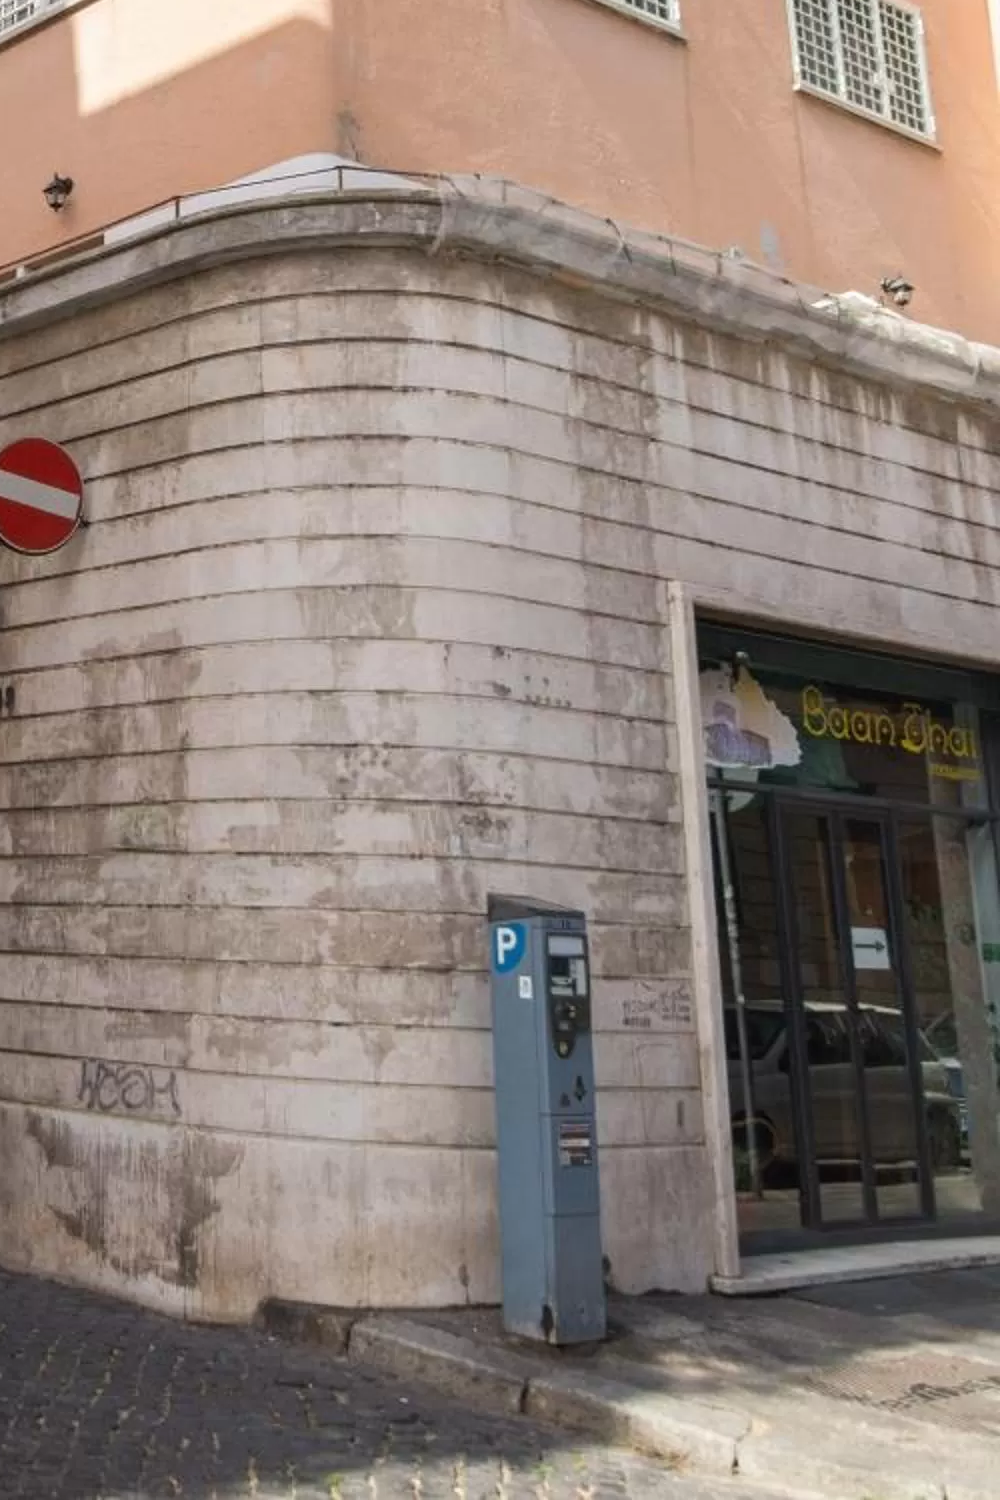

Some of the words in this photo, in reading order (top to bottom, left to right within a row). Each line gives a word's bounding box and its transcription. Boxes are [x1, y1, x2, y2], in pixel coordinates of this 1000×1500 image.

[803, 685, 898, 747] Baan
[901, 702, 979, 759] Thai
[496, 927, 517, 965] P
